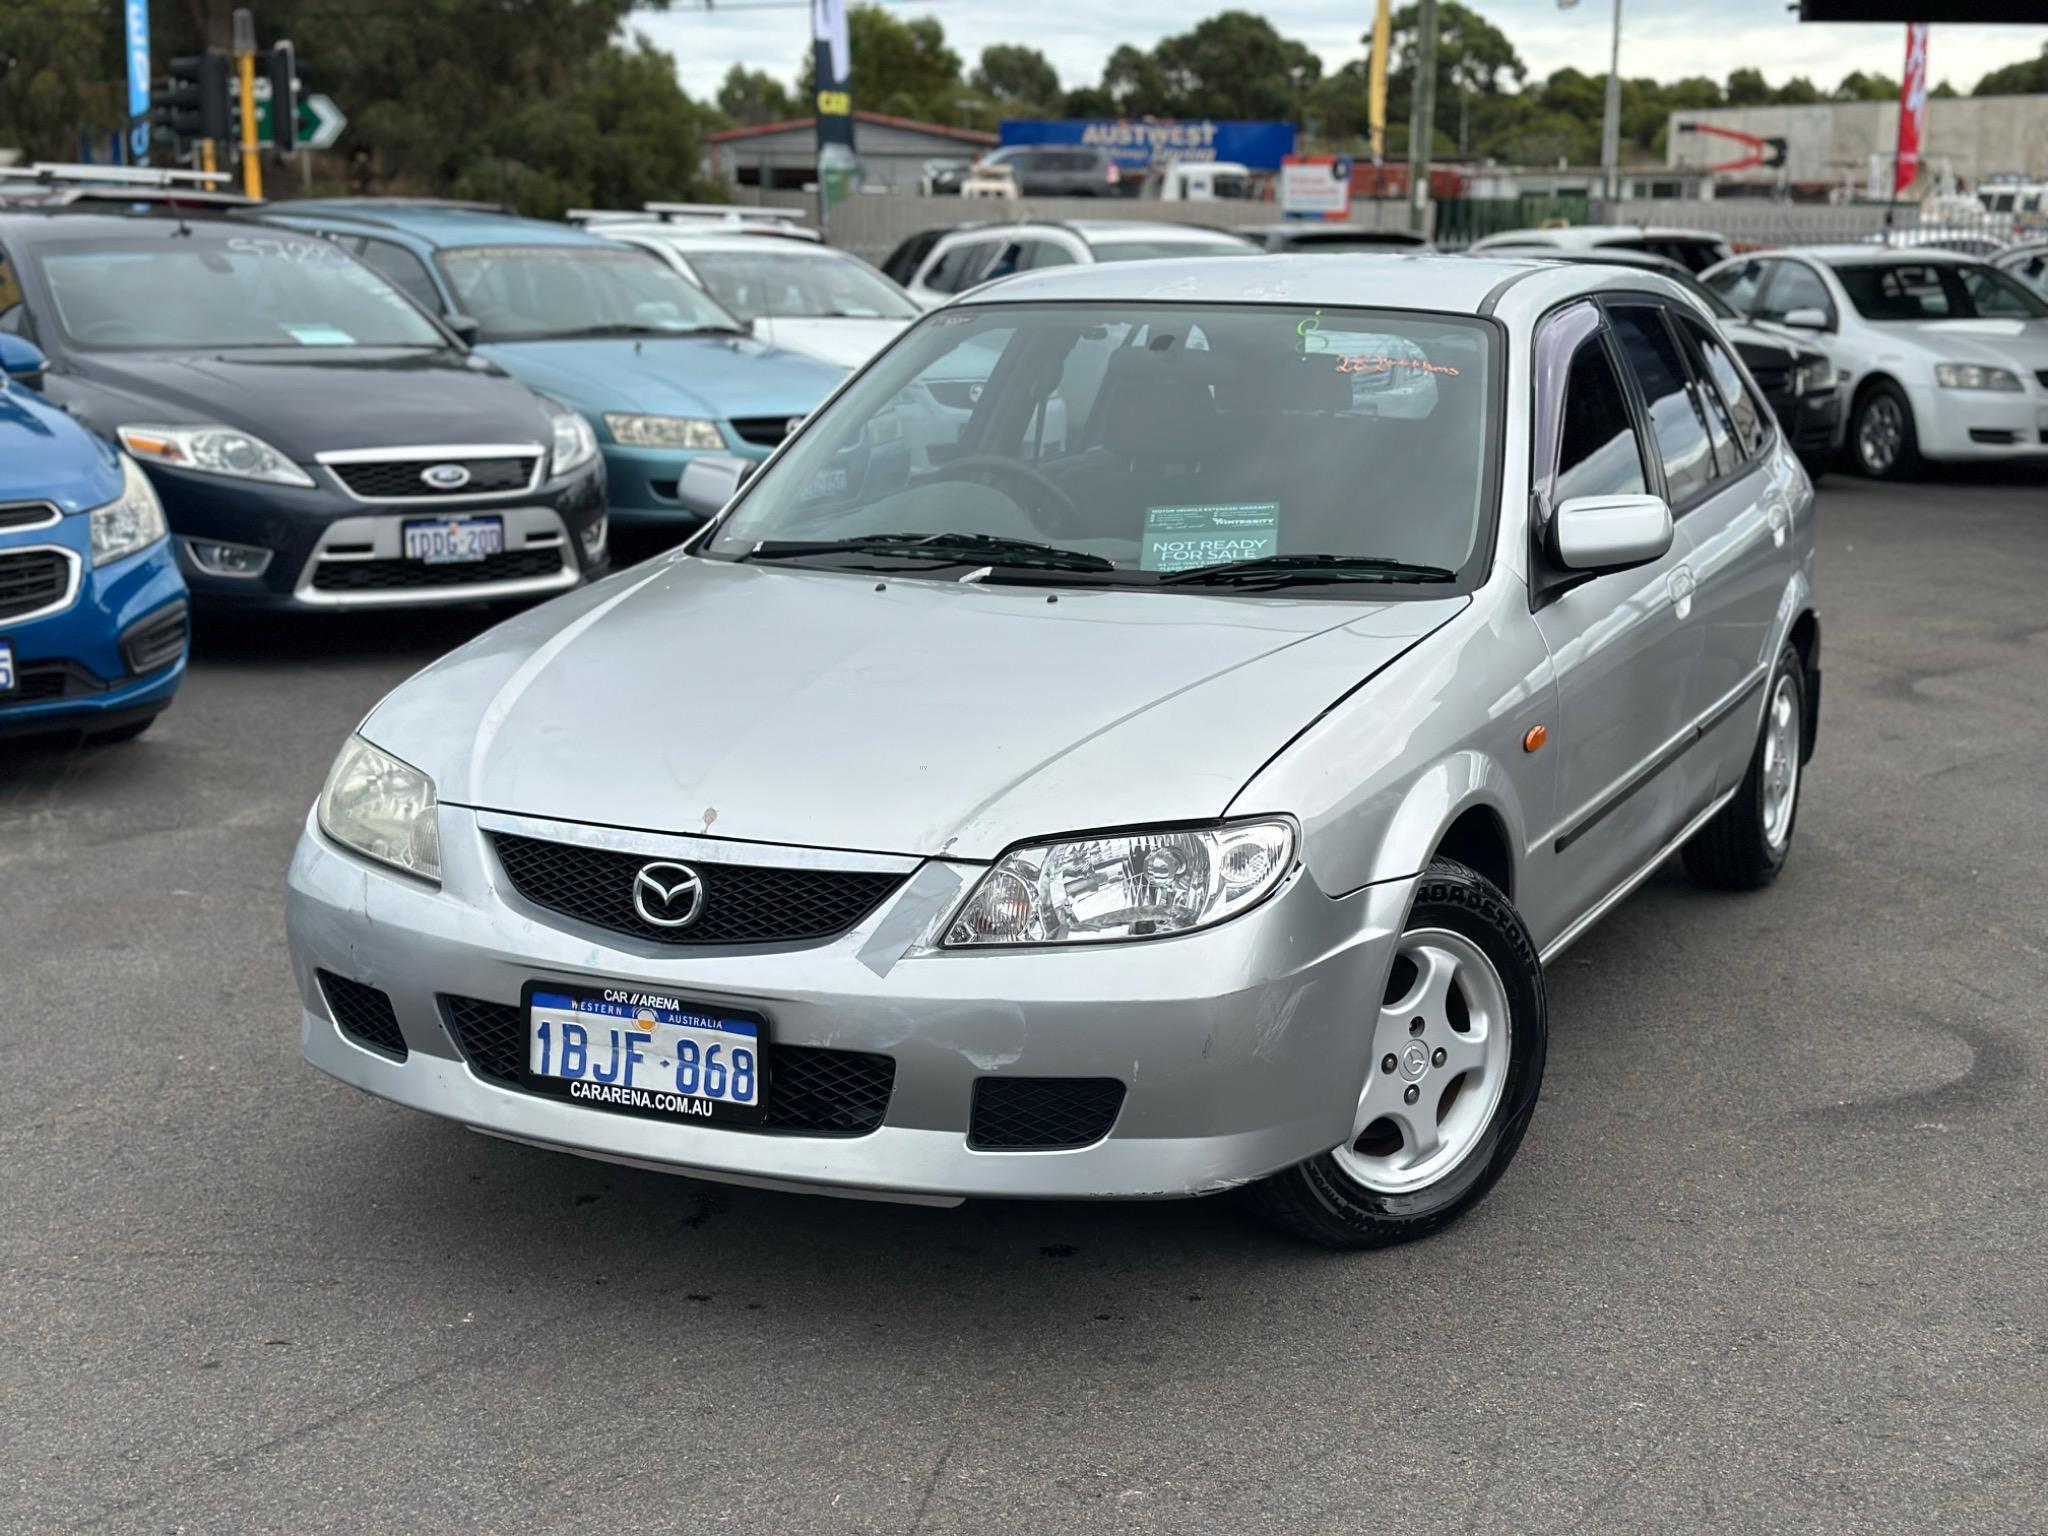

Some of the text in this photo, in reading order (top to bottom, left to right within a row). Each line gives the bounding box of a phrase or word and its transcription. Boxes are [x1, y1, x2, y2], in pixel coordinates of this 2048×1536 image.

[1081, 123, 1218, 146] AUSTWEST
[1153, 539, 1268, 553] NOT READY
[1161, 548, 1257, 562] FOR SALE
[571, 999, 723, 1030] WESTERN AUSTRALIA
[570, 1081, 713, 1117] CARARENA.COM.AU
